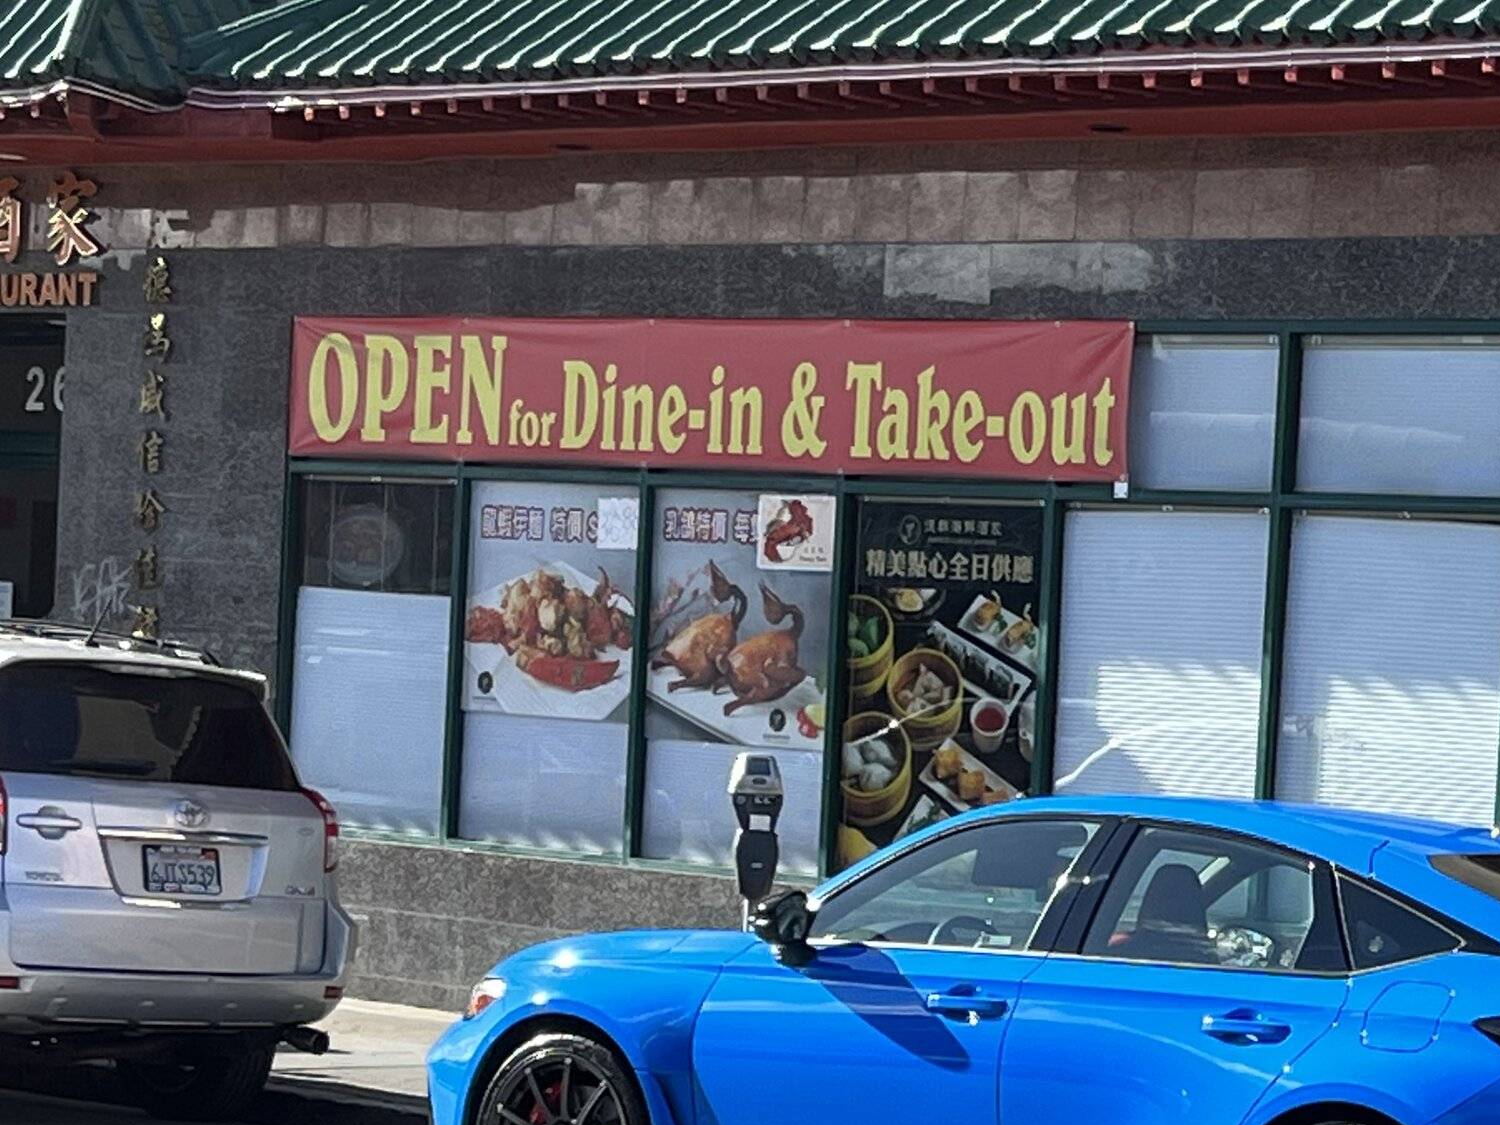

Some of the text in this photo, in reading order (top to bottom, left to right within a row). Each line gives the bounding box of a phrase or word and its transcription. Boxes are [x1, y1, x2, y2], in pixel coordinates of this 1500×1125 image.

[308, 332, 1116, 466] OPEN for Dine-in & Take-out
